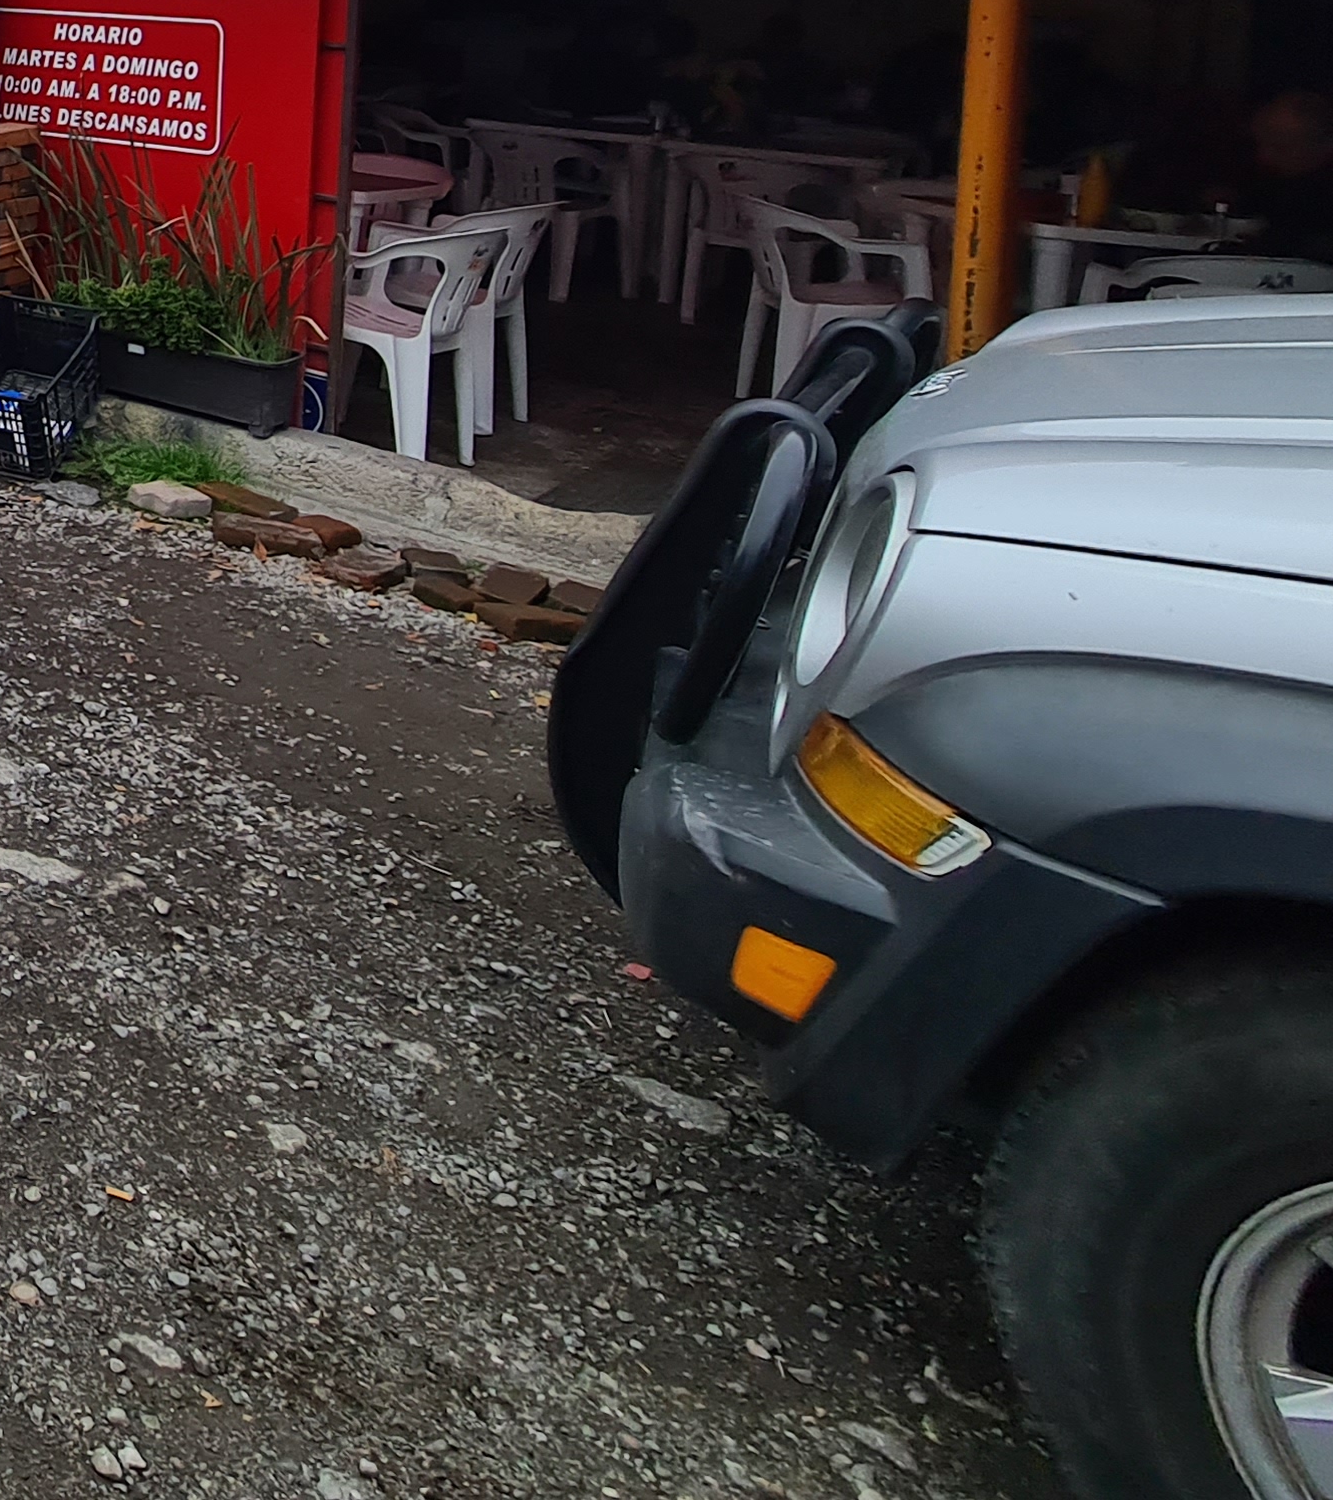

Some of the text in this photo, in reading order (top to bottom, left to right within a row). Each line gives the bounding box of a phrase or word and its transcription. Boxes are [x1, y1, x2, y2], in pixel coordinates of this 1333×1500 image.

[53, 22, 143, 46] HORARIO
[2, 47, 199, 80] MARTES A DOMINGO
[46, 79, 81, 99] AM.
[86, 83, 100, 100] A
[107, 84, 161, 106] 18:00
[166, 90, 207, 112] P.M.
[56, 108, 208, 141] DESCANSAMOS
